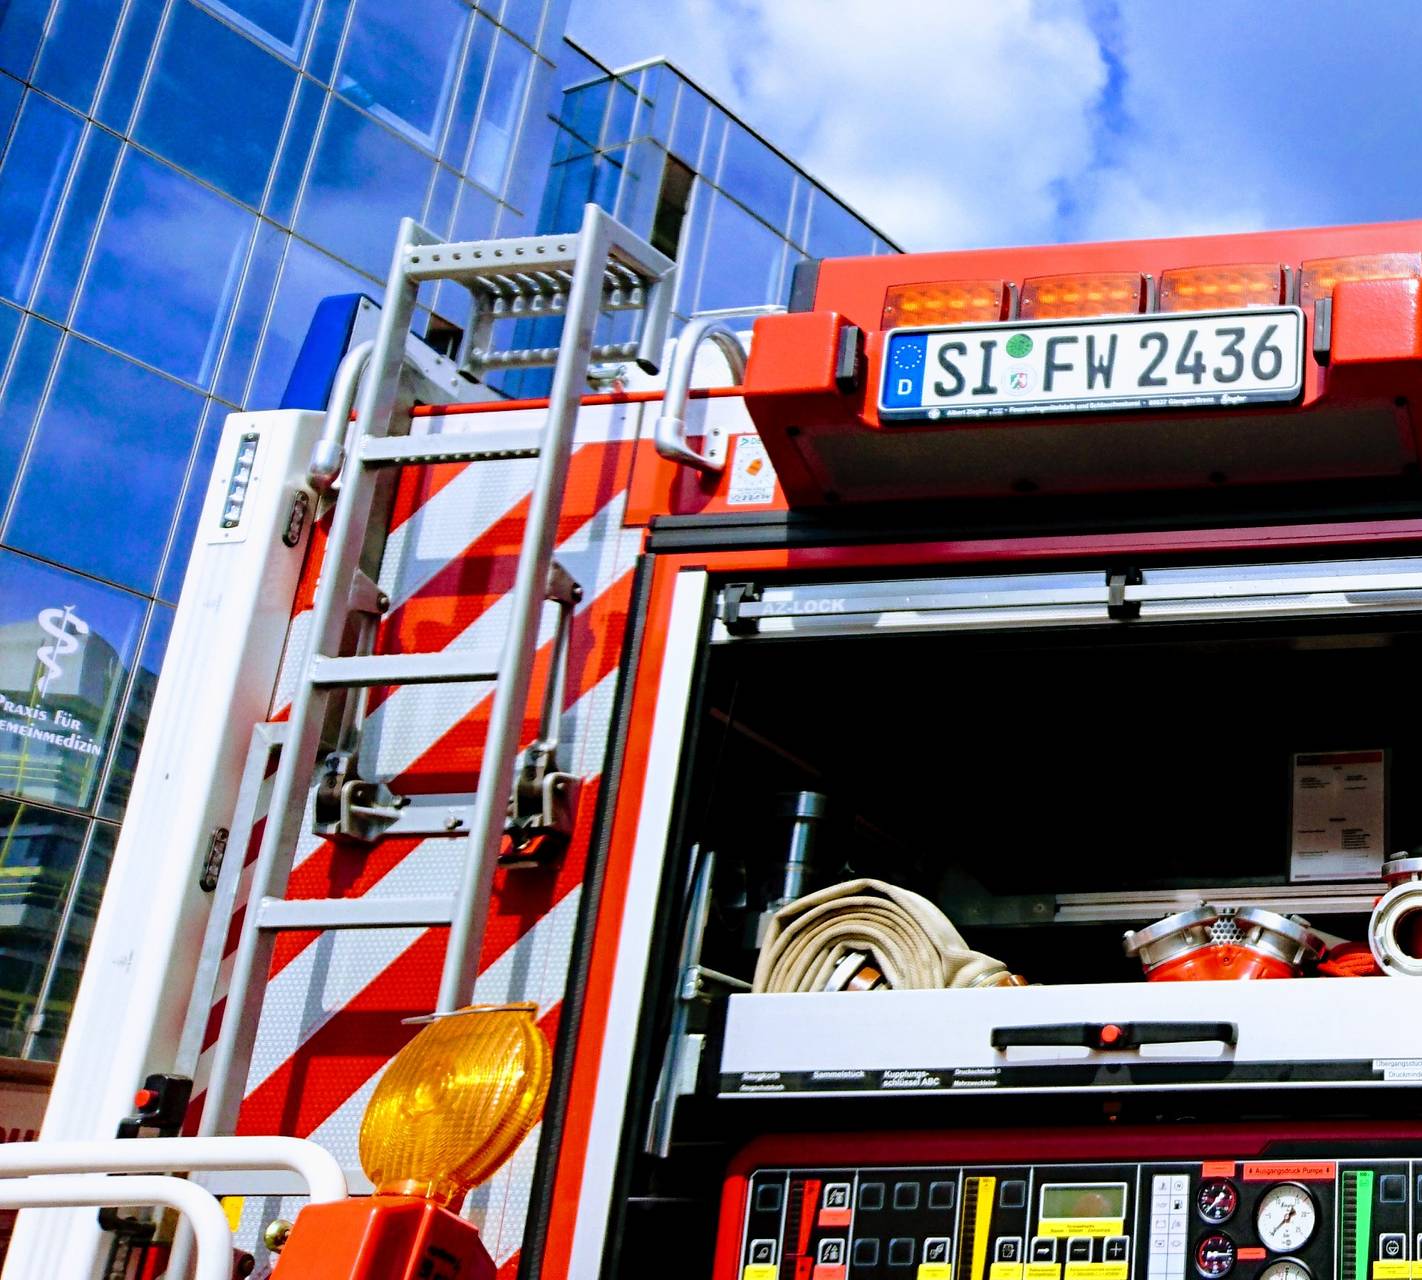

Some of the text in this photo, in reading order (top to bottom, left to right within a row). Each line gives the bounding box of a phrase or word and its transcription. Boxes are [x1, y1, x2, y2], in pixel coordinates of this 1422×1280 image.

[934, 324, 1283, 397] SI FW 2436
[897, 379, 913, 395] D
[1303, 1167, 1323, 1175] Pumpe
